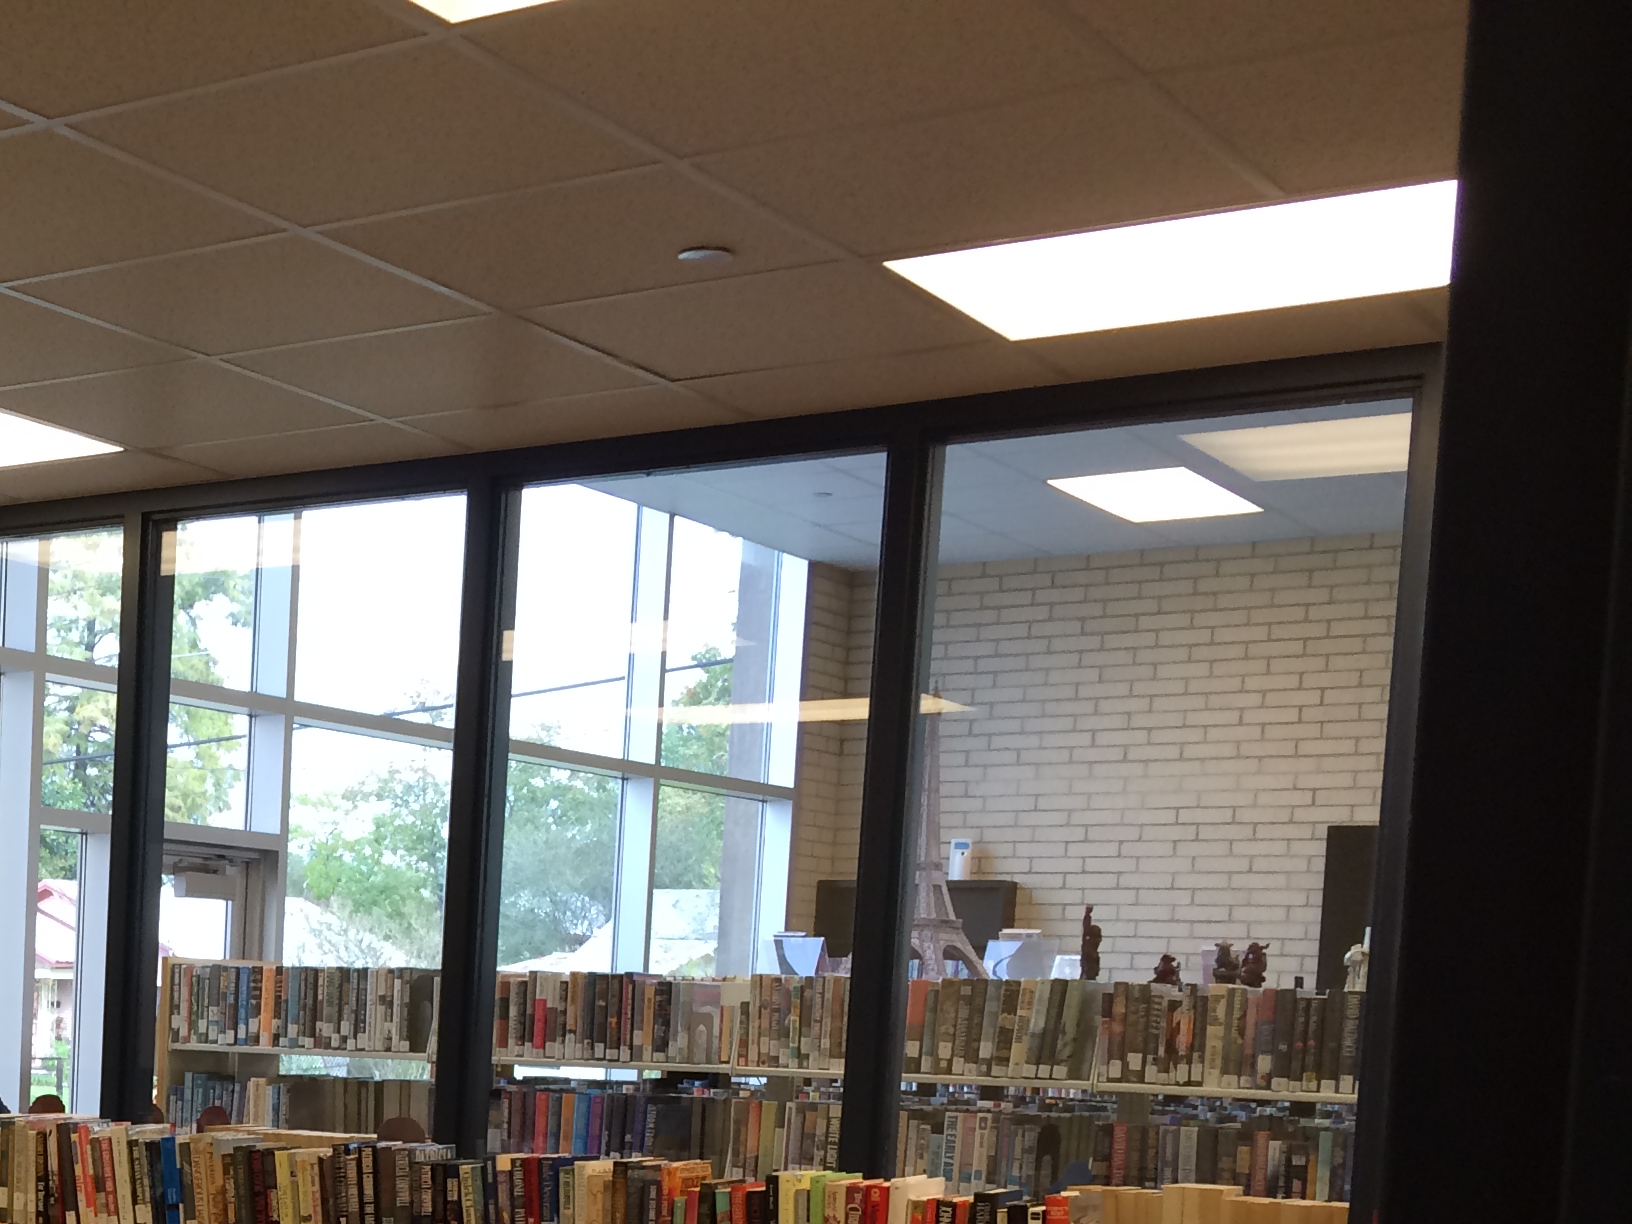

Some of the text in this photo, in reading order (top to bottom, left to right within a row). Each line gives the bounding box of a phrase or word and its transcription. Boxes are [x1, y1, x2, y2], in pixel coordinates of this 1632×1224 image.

[947, 1115, 958, 1132] THE
[395, 1150, 409, 1207] PATRICIA CORNWELL
[420, 1165, 432, 1216] PATRICIA CORNWELL
